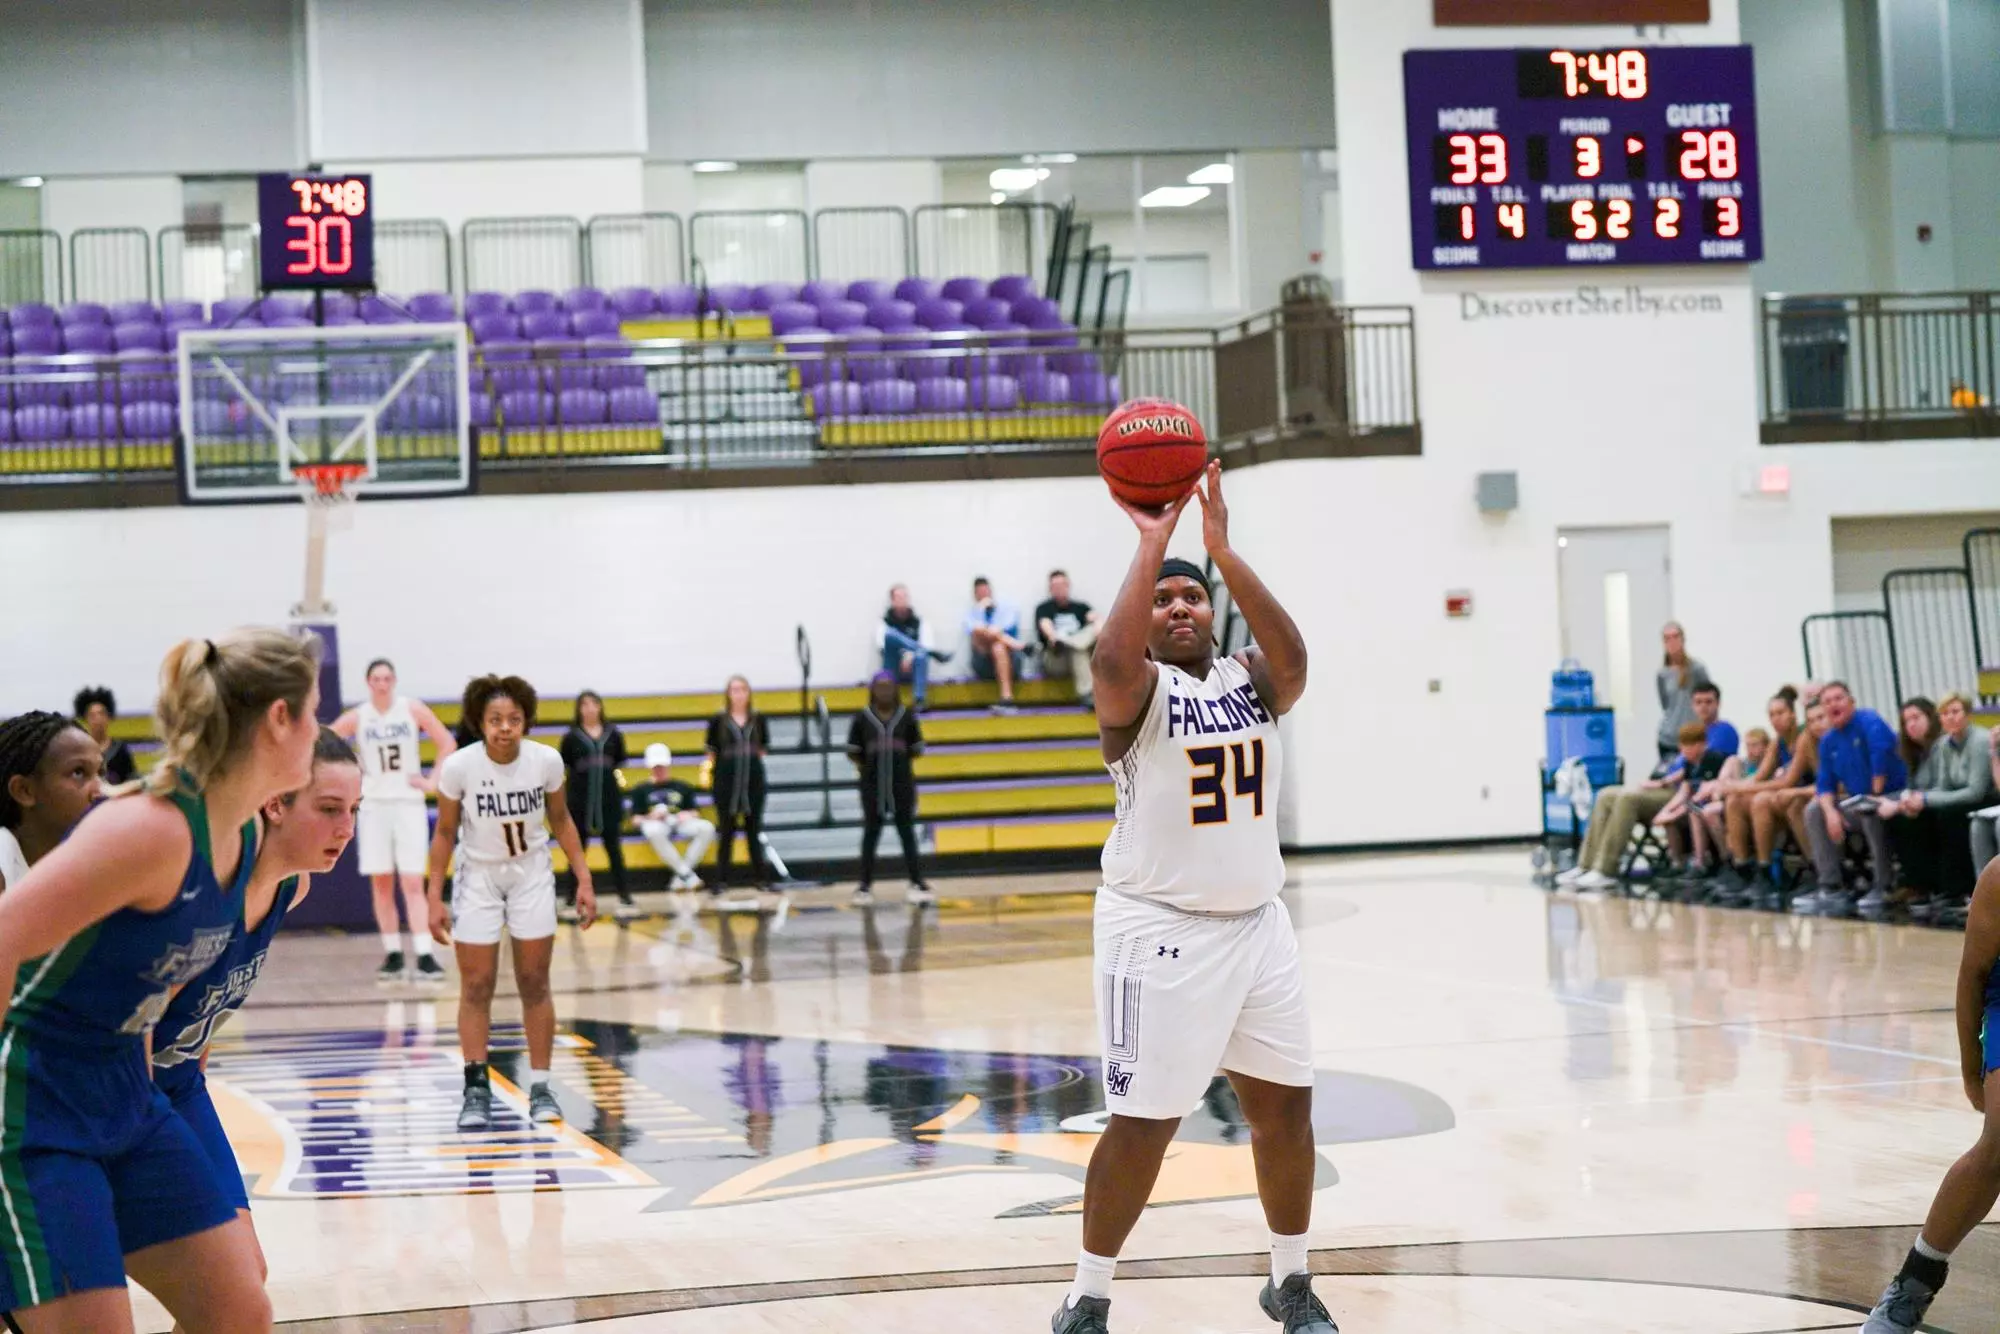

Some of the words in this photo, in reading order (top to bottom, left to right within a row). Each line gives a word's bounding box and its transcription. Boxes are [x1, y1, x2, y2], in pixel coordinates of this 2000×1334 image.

[1550, 50, 1647, 99] 7:48
[1438, 107, 1498, 131] HOME
[1560, 117, 1611, 135] PERIOD
[1666, 103, 1731, 127] GUEST
[1450, 135, 1507, 184] 33
[1576, 137, 1601, 178] 3
[1680, 131, 1737, 179] 28
[292, 179, 366, 216] 7:48
[1431, 186, 1477, 204] FOULS
[1698, 181, 1743, 199] FOULS
[1461, 205, 1474, 239] 1
[1498, 203, 1525, 238] 4
[1655, 198, 1680, 238] 2
[1717, 197, 1740, 236] 3
[287, 215, 352, 274] 30
[1117, 414, 1194, 438] Wilson
[1168, 682, 1270, 738] FALCONS
[377, 744, 402, 773] 12
[1184, 736, 1265, 828] 34
[501, 820, 529, 858] 11
[1107, 1061, 1133, 1096] UM
